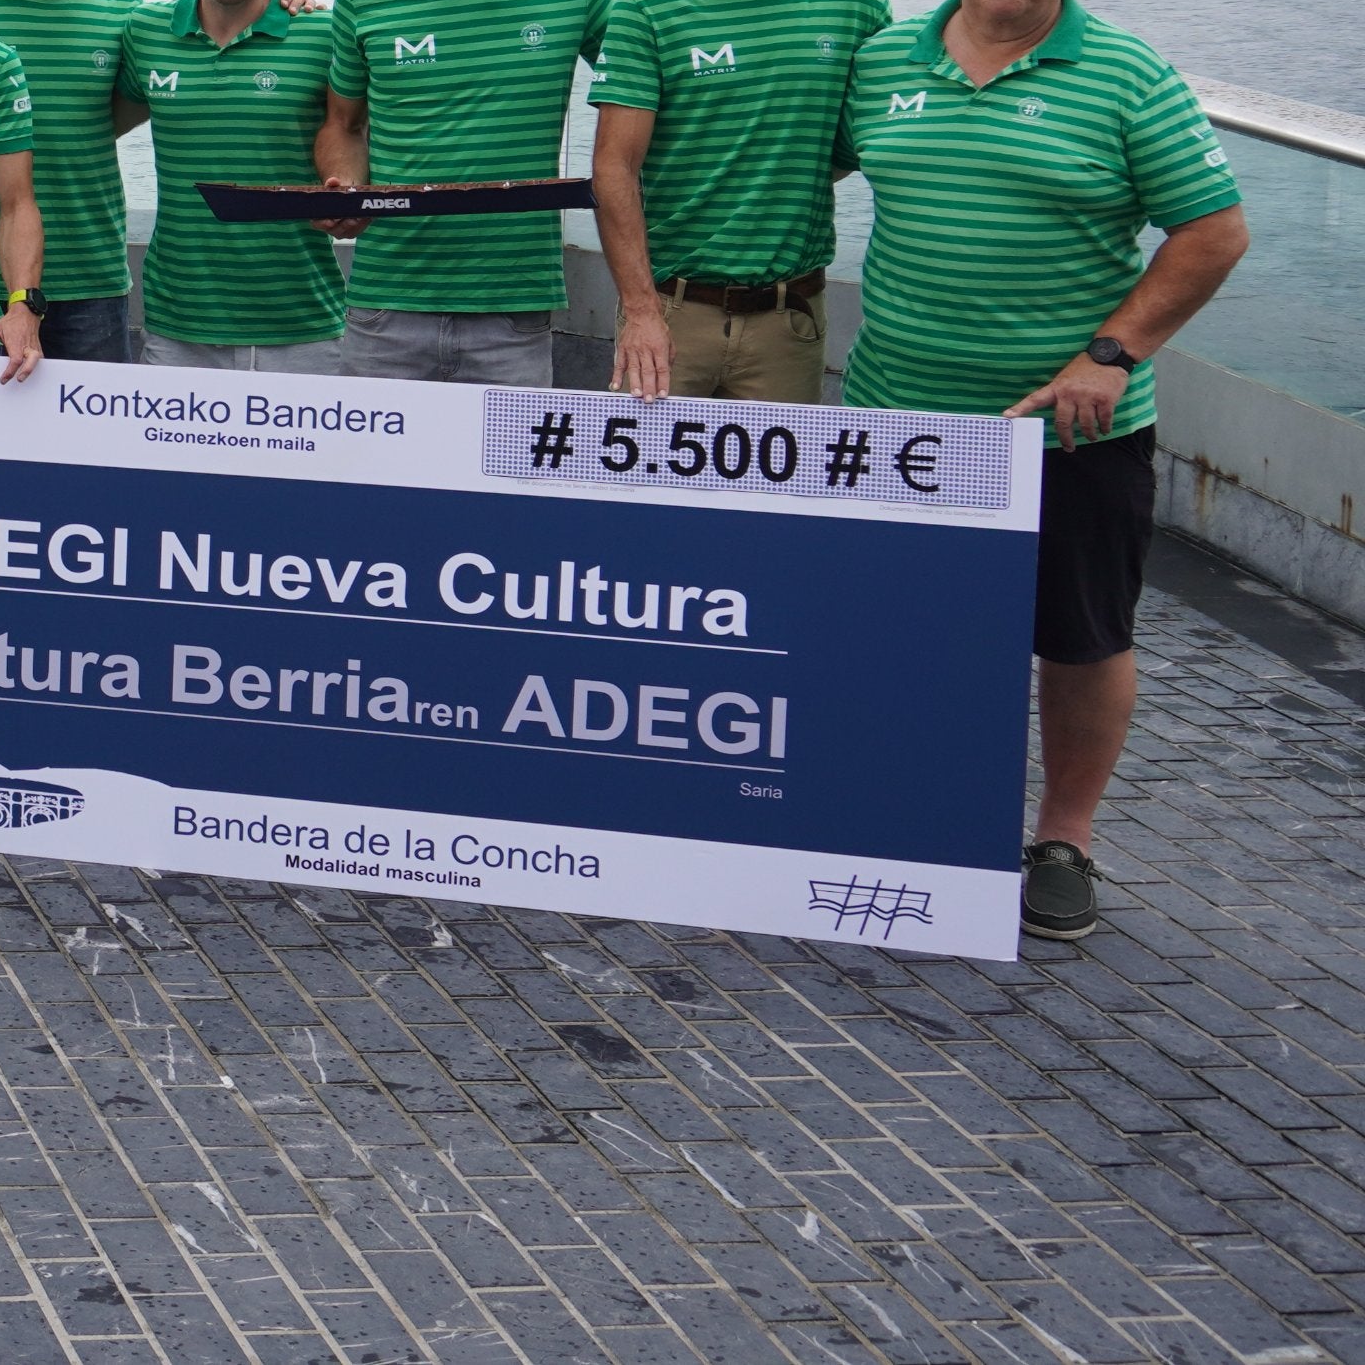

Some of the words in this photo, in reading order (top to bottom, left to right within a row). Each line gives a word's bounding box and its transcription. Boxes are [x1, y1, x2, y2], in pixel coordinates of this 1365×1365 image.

[396, 57, 437, 65] MATRIX
[694, 67, 737, 76] MATRIX
[361, 197, 411, 210] ADEGI
[59, 384, 232, 424] Kontxako
[247, 395, 406, 435] Bandera
[143, 427, 261, 449] Gizonezkoen
[266, 435, 316, 452] maila
[600, 417, 799, 483] 5.500
[894, 435, 942, 493] €
[159, 531, 408, 609] Nueva
[438, 552, 749, 637] Cultura
[171, 644, 479, 730] Berriaren
[501, 674, 788, 759] ADEGI
[739, 782, 783, 799] Saria
[173, 805, 330, 851] Bandera
[343, 824, 391, 856] de
[406, 830, 436, 861] la
[451, 834, 601, 878] Concha
[285, 854, 381, 879] Modalidad
[386, 865, 482, 888] masculina
